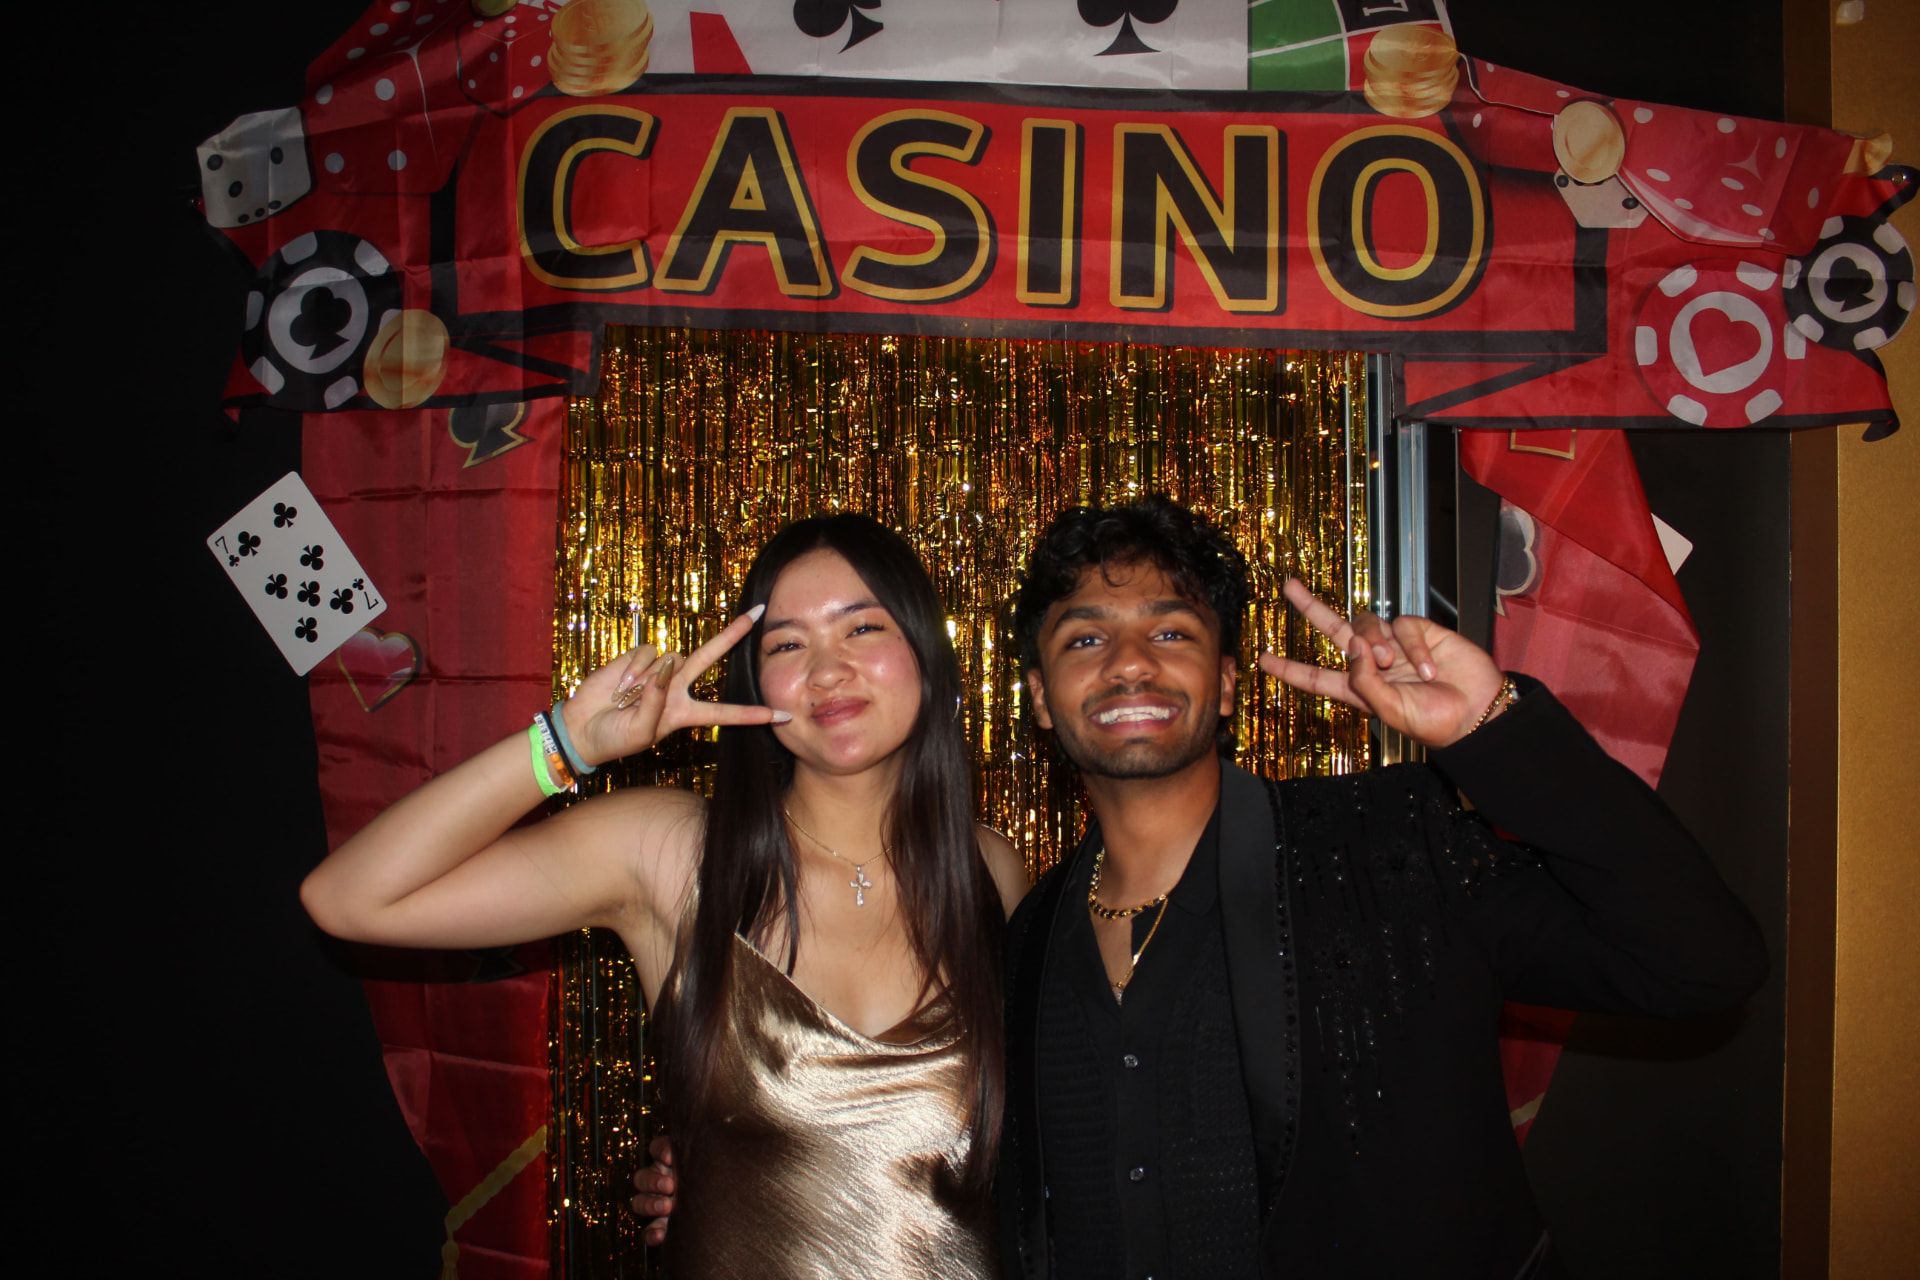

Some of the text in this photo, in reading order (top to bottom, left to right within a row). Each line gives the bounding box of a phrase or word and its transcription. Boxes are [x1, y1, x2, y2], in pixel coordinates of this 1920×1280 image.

[516, 103, 1490, 318] CASINO
[214, 535, 229, 554] 7
[364, 591, 379, 610] 7
